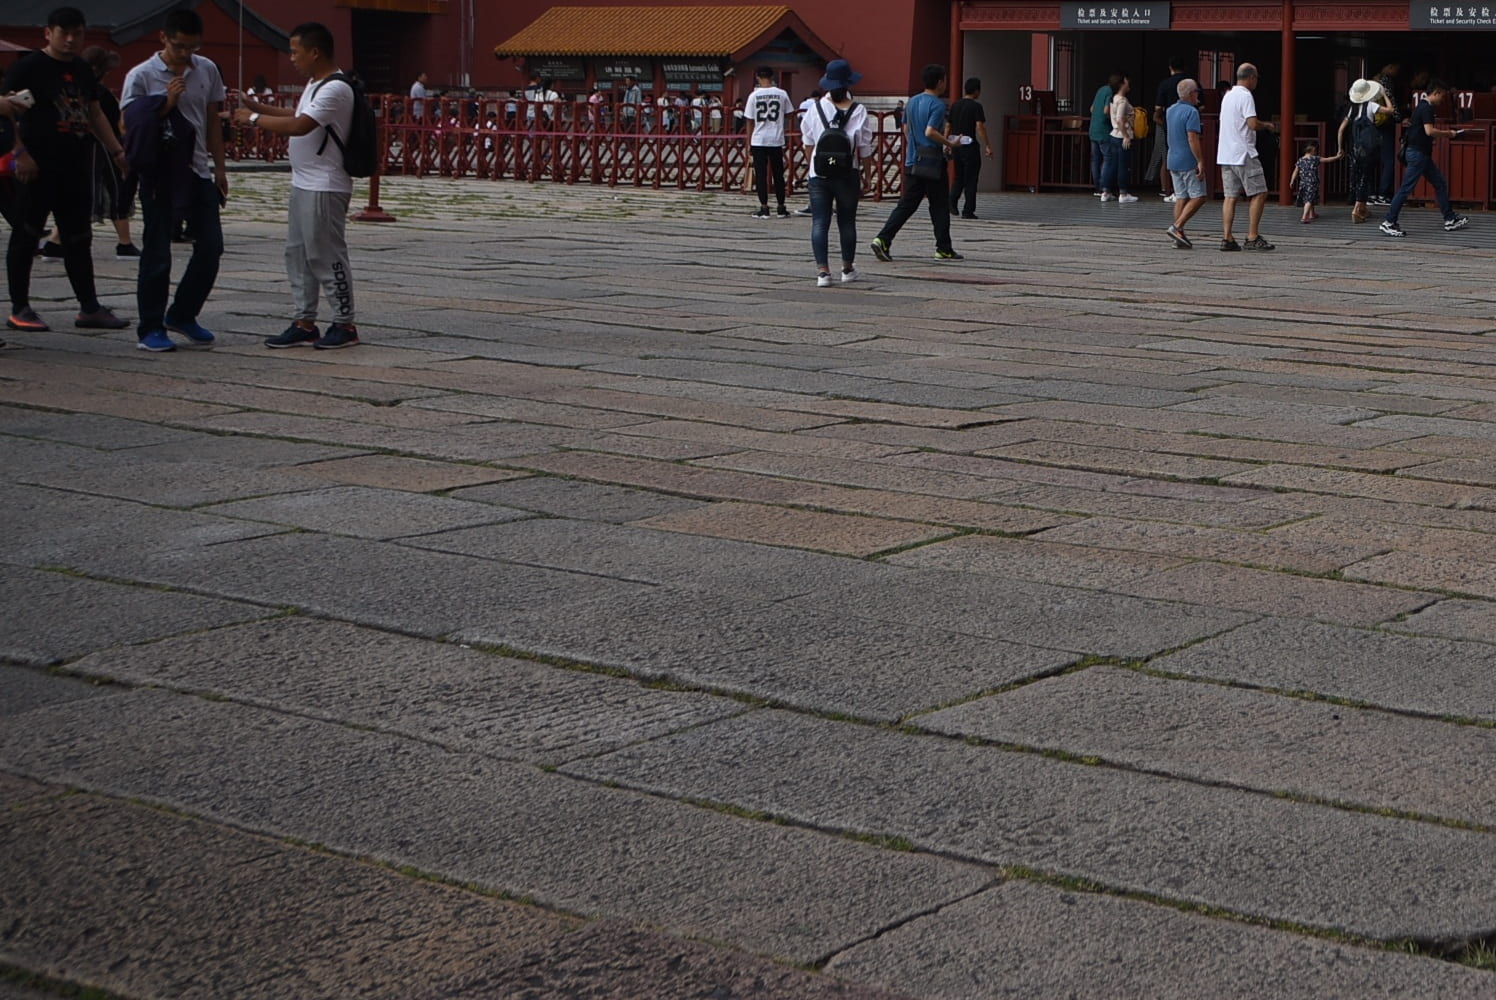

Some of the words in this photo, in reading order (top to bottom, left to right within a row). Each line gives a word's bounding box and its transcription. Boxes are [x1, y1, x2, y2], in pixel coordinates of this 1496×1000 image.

[1019, 85, 1032, 101] 13
[1458, 92, 1473, 108] 17
[756, 100, 781, 122] 23
[332, 262, 351, 315] adidas
